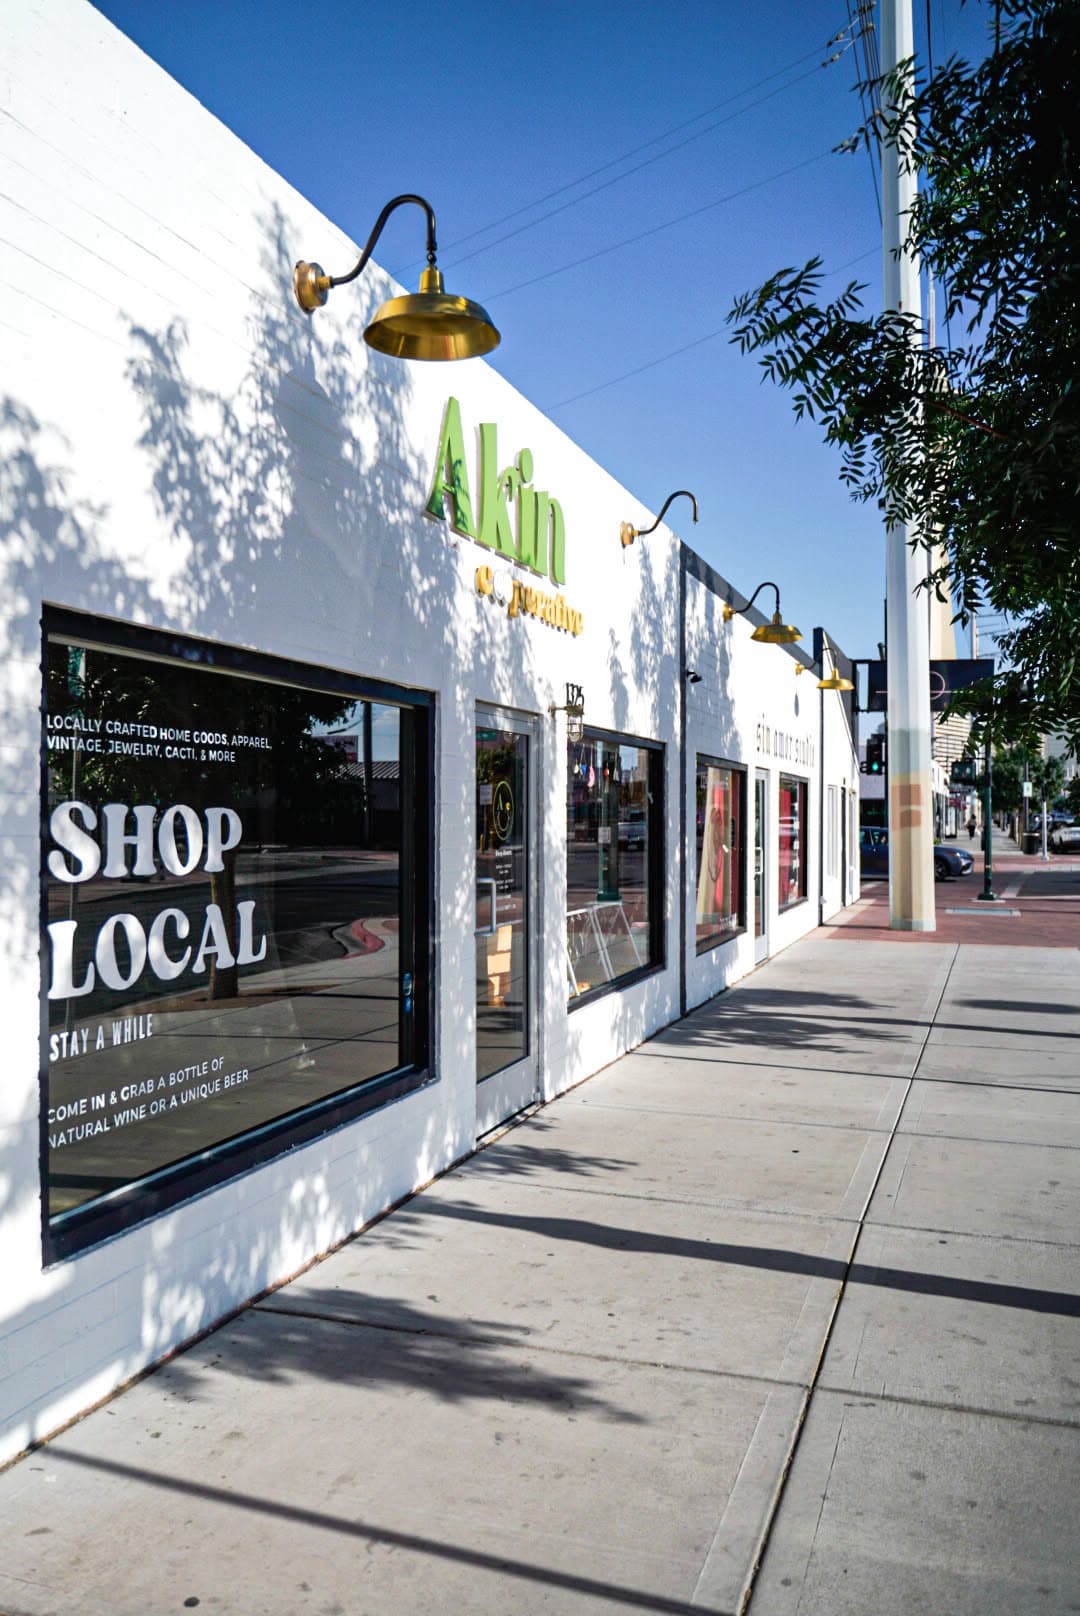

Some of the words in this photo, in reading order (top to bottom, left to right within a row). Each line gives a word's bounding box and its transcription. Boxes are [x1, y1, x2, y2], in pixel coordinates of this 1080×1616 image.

[424, 396, 566, 585] Akin
[47, 715, 102, 733] LOCALLY
[105, 720, 157, 739] CRAFTED
[159, 728, 191, 743] HOME
[193, 731, 229, 746] GOODS,
[231, 735, 273, 751] APPAREL,
[47, 735, 106, 755] VINTAGE,
[108, 739, 162, 759] JEWELRY,
[165, 746, 198, 761] CACTI,
[200, 750, 206, 761] &
[208, 750, 236, 763] MORE
[47, 801, 242, 883] SHOP
[47, 900, 267, 1000] LOCAL
[49, 1027, 90, 1062] STAY
[95, 1025, 105, 1050] A
[111, 1013, 153, 1046] WHILE
[48, 1098, 88, 1124] COME
[91, 1093, 106, 1112] IN
[110, 1090, 118, 1106] &
[120, 1080, 154, 1102] GRAB
[157, 1077, 167, 1089] A
[169, 1061, 209, 1087] BOTTLE
[211, 1056, 225, 1071] OF
[48, 1119, 112, 1149] NATURAL
[114, 1109, 147, 1126] WINE
[150, 1099, 167, 1115] OR
[169, 1096, 178, 1108] A
[180, 1083, 222, 1105] UNIQUE
[224, 1069, 249, 1090] BEER
